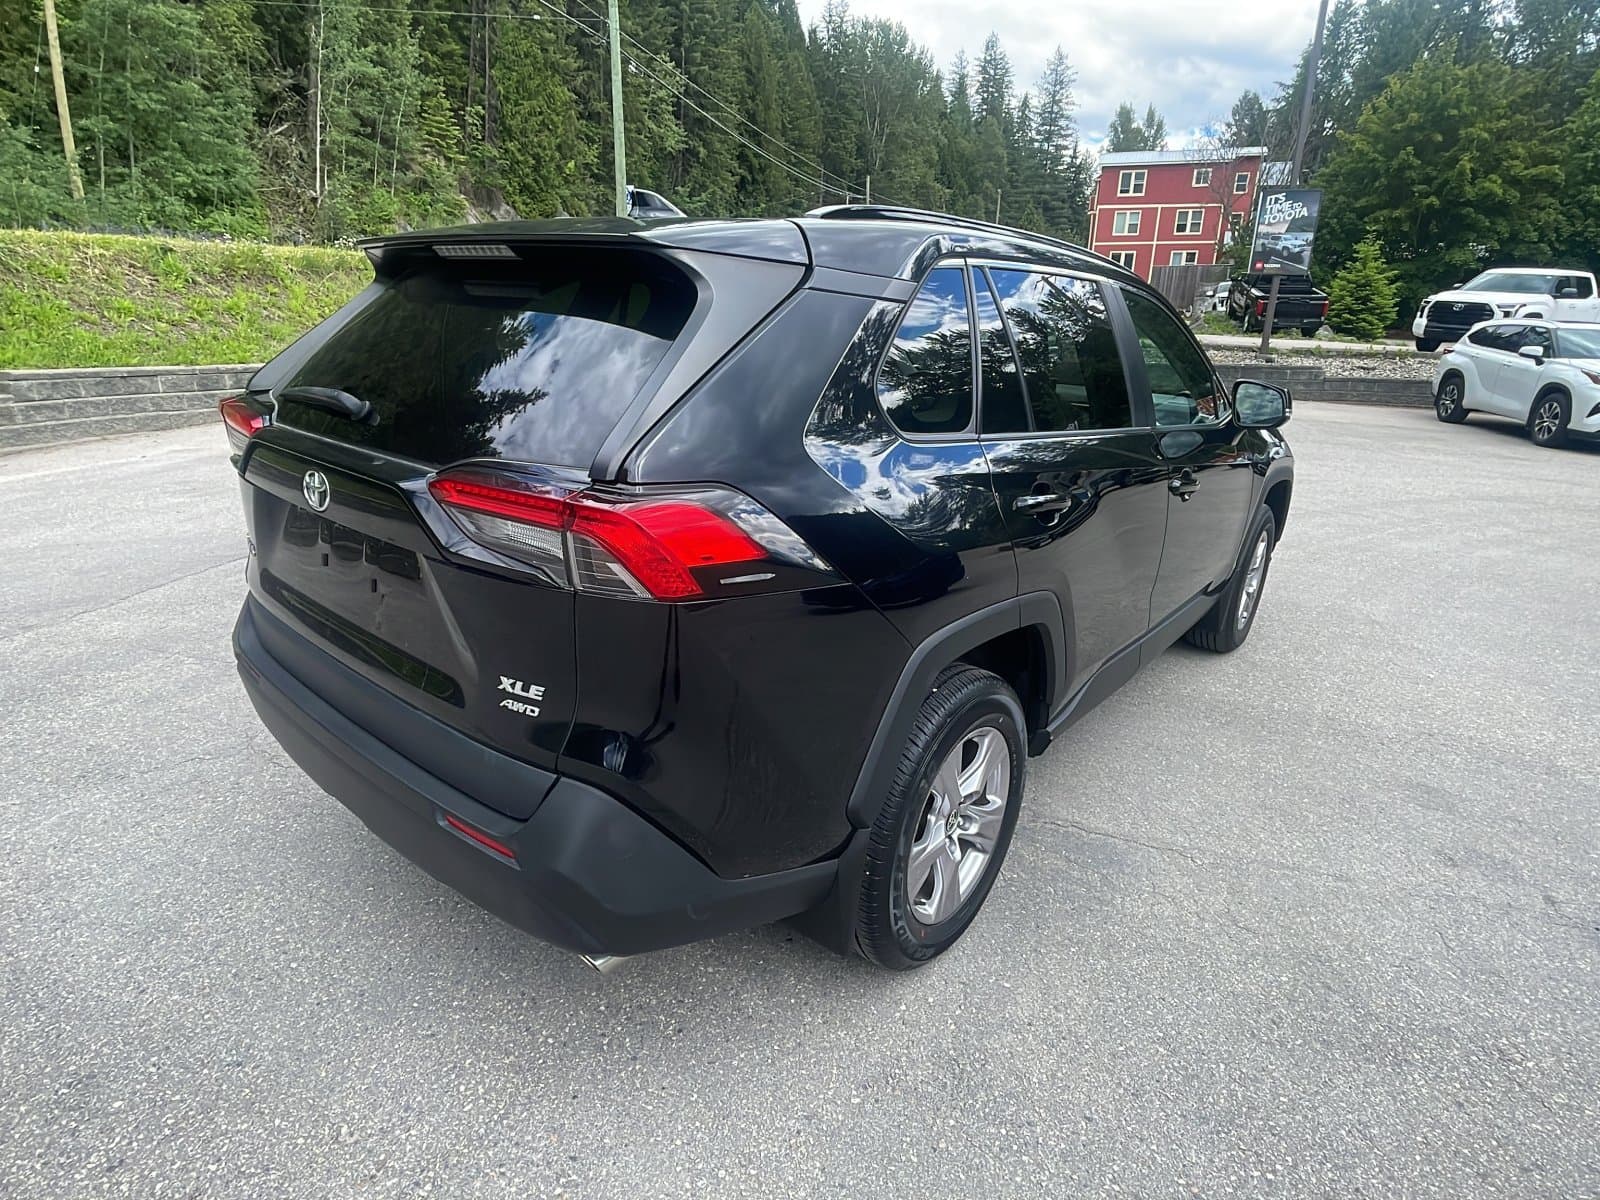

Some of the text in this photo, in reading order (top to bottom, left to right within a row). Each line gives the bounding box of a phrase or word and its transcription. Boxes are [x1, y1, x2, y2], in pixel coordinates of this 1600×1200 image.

[1265, 201, 1303, 215] TIME TO
[1266, 192, 1286, 206] IT'S
[1263, 207, 1308, 225] TOYOTA
[497, 675, 546, 701] XLE
[499, 699, 540, 717] AWD
